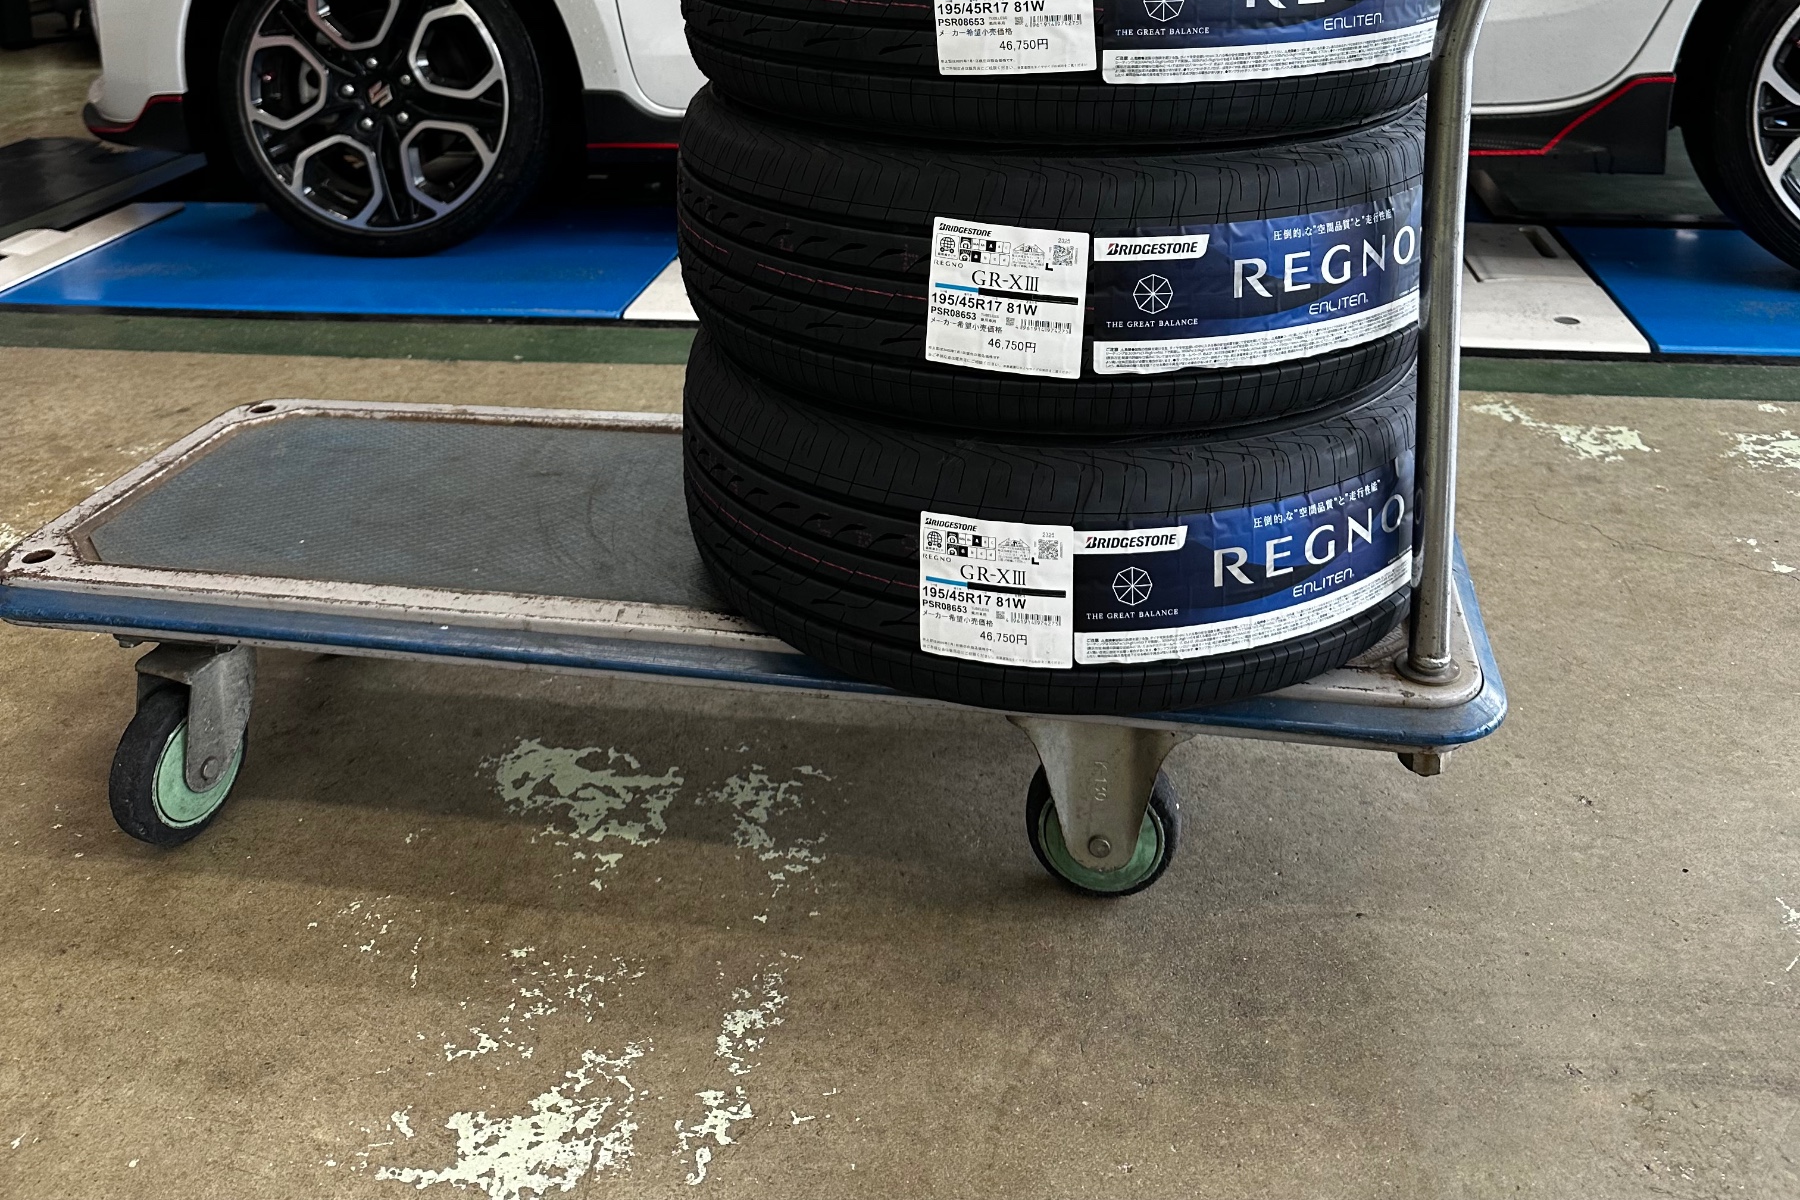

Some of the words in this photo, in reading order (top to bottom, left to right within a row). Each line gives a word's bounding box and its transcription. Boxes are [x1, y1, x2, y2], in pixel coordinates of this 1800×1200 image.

[938, 2, 1009, 15] 195/45R17
[1014, 1, 1044, 12] 81W
[938, 18, 985, 27] PSR08653
[1170, 27, 1210, 35] BALANCE
[939, 223, 992, 237] BRIDGESTONE
[1107, 242, 1198, 255] BRIDGESTONE
[934, 260, 963, 268] REGNO
[1234, 226, 1415, 299] REGNO
[932, 293, 1002, 312] 195/45R17
[1007, 303, 1037, 316] 81W
[931, 306, 976, 320] PSR08653
[931, 318, 1002, 333] メーカー希望小売価格
[925, 518, 977, 532] BRIDGESTONE
[1085, 534, 1176, 548] BRIDGESTONE
[1213, 493, 1404, 587] REGNO
[923, 553, 951, 562] REGNO
[923, 586, 991, 605] 195/45R17
[996, 597, 1026, 609] 81W
[923, 600, 967, 613] PSR08653
[923, 610, 993, 627] メーカー希望小売価格
[1107, 611, 1135, 619] GREAT
[1139, 609, 1178, 618] BALANCE
